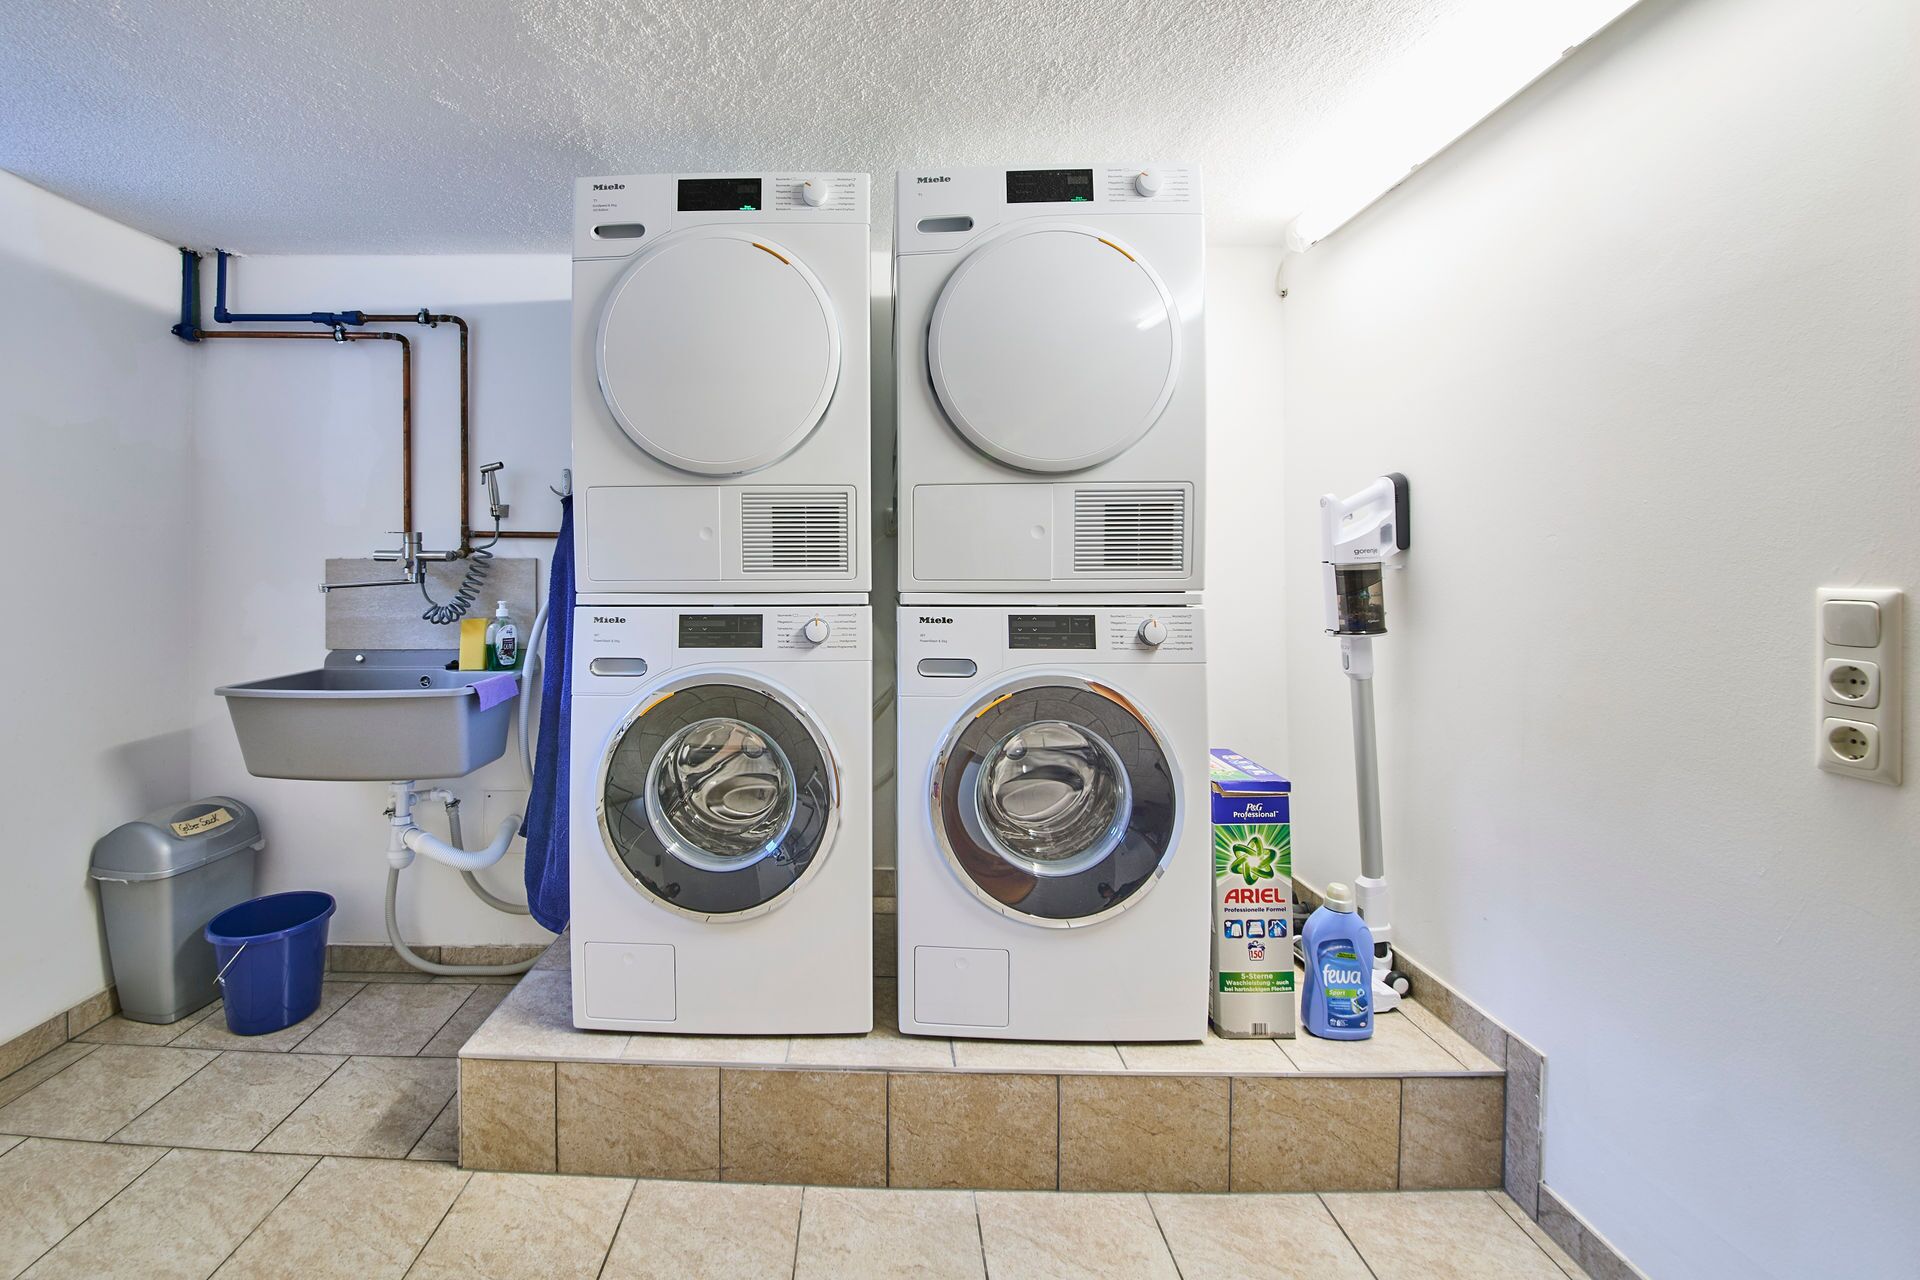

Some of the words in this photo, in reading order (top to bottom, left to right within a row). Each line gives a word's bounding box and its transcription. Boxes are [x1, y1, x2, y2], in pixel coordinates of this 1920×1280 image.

[917, 176, 951, 184] Miele
[593, 616, 626, 624] Miele
[919, 616, 954, 624] Miele
[1246, 803, 1263, 812] P&G
[1224, 888, 1286, 904] ARIEL
[1250, 950, 1263, 959] 150
[1322, 963, 1362, 987] fewa
[1225, 979, 1271, 987] Waschleistung
[1329, 989, 1346, 998] Sport
